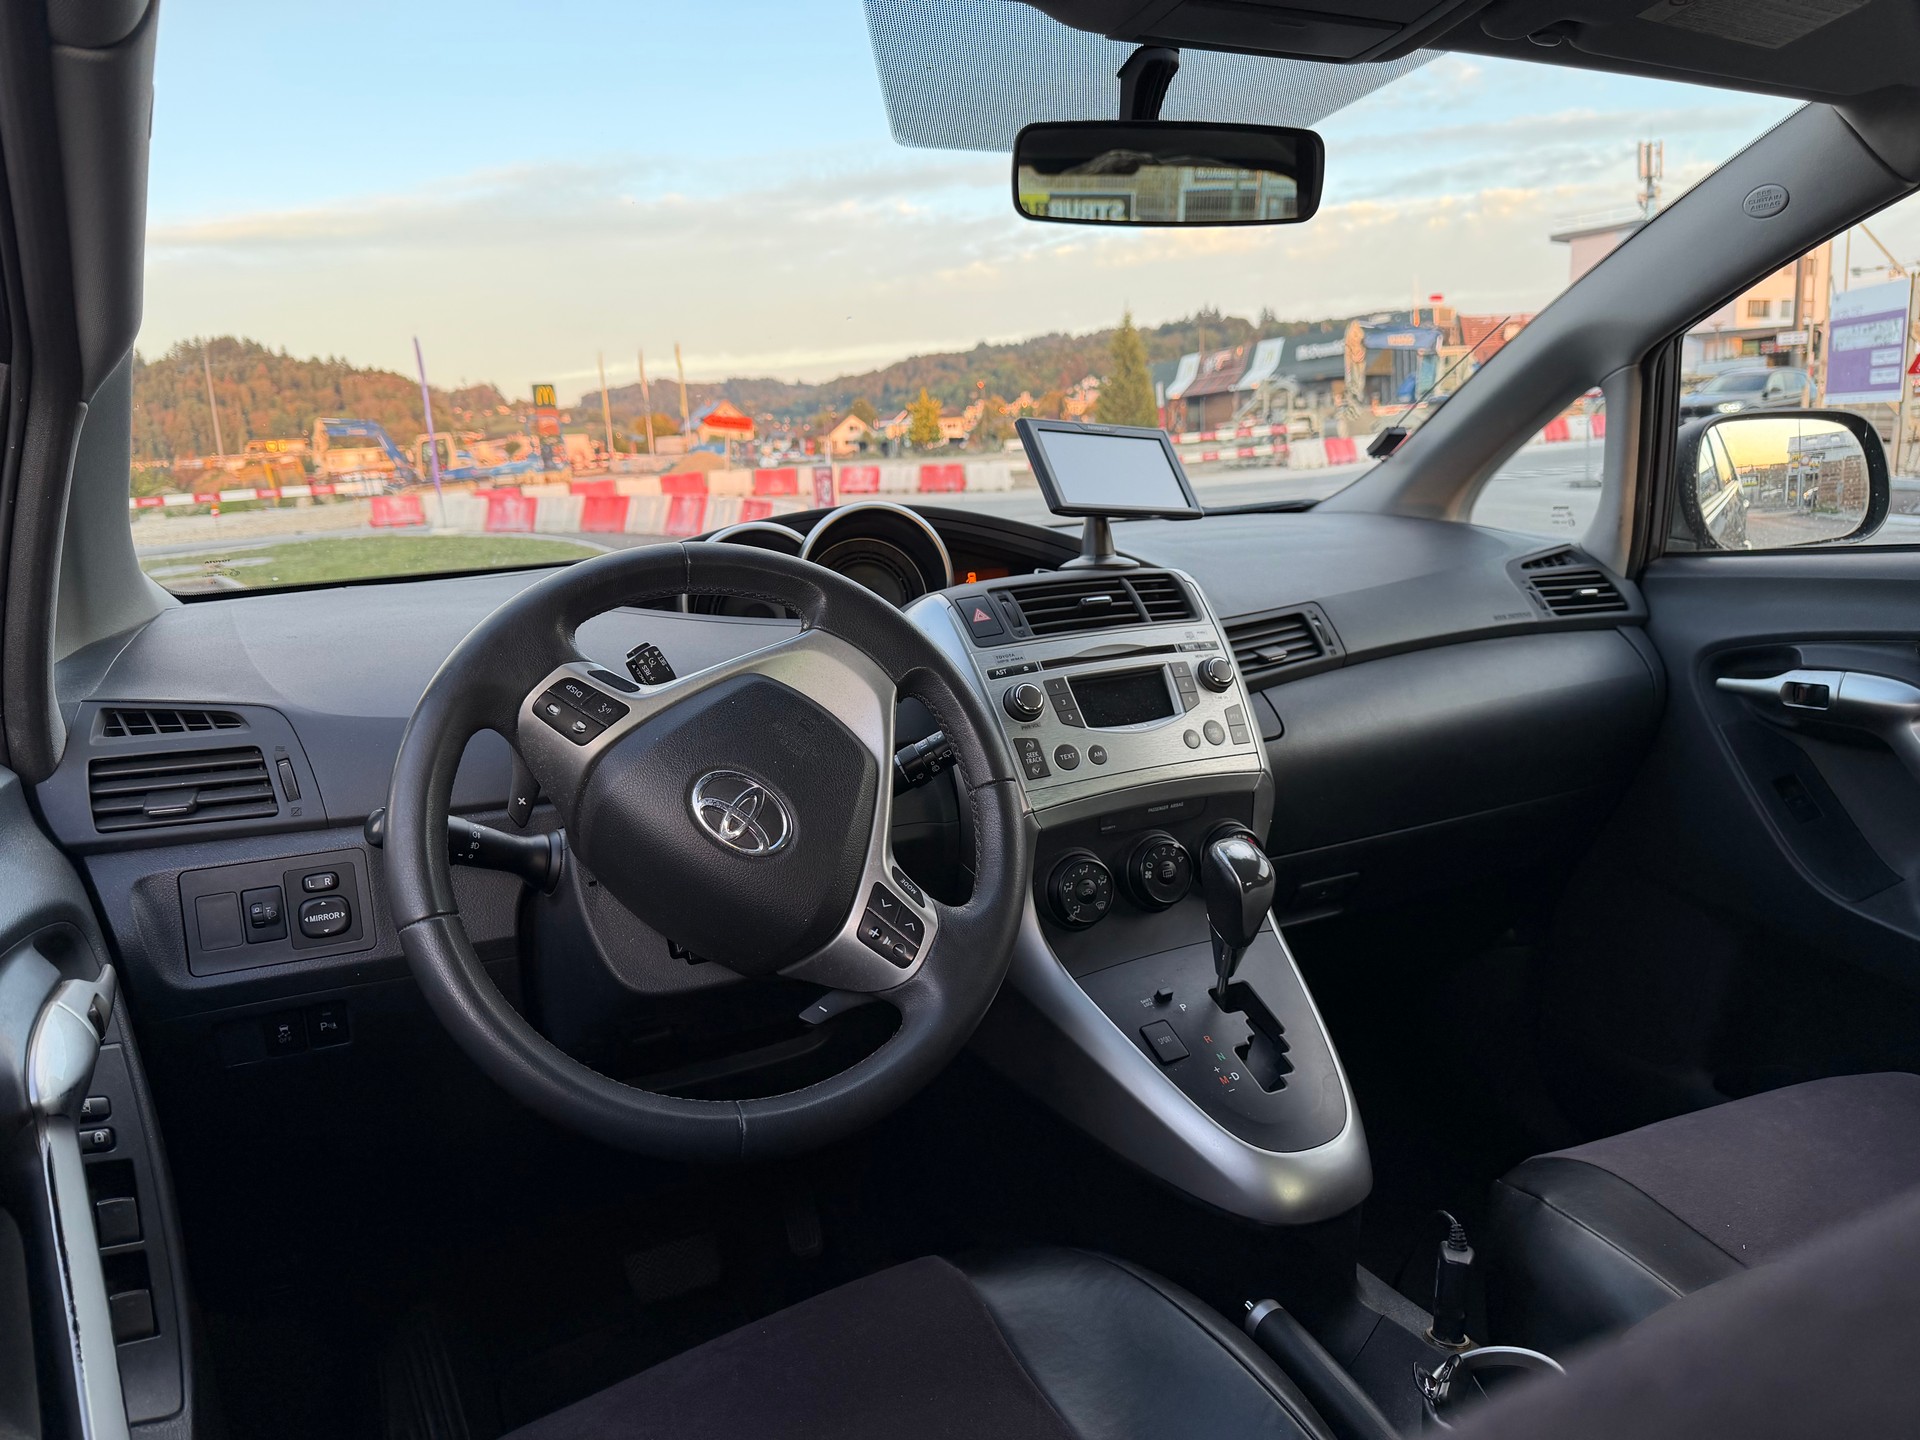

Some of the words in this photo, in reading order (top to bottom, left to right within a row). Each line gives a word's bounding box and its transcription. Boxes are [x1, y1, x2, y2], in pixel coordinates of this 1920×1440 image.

[1748, 193, 1782, 205] CURTAIN
[1750, 200, 1781, 211] AIRBAG
[657, 655, 667, 666] SET
[641, 664, 652, 676] RES
[565, 683, 584, 699] DISP
[1025, 756, 1042, 764] TRACK
[1060, 752, 1075, 761] TEXT
[1148, 804, 1169, 813] PASSENGER
[1161, 847, 1167, 856] 2
[1170, 848, 1176, 857] 3
[1177, 855, 1184, 863] 4
[308, 880, 315, 888] L
[324, 877, 331, 886] R
[900, 879, 918, 894] MODE
[309, 911, 340, 923] MIRROR
[1179, 1003, 1187, 1012] P
[1157, 1035, 1172, 1045] SPORT
[1203, 1035, 1213, 1044] R
[1216, 1052, 1226, 1061] N
